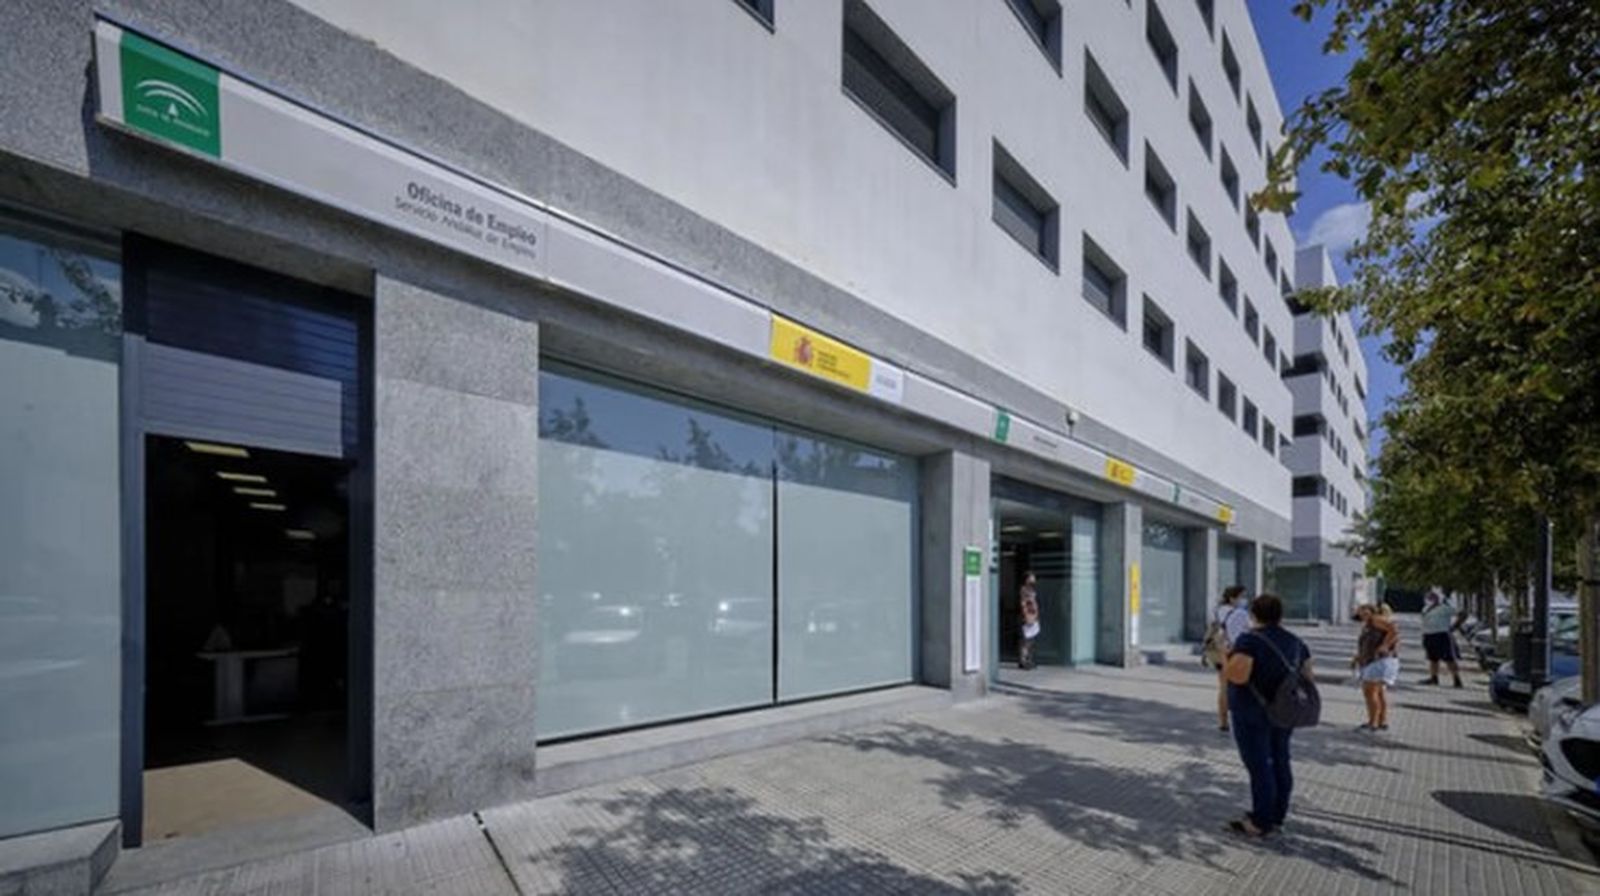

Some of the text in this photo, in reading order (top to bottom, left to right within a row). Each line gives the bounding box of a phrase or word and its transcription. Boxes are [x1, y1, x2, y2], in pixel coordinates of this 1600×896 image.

[407, 181, 536, 246] Oficina de Empleo
